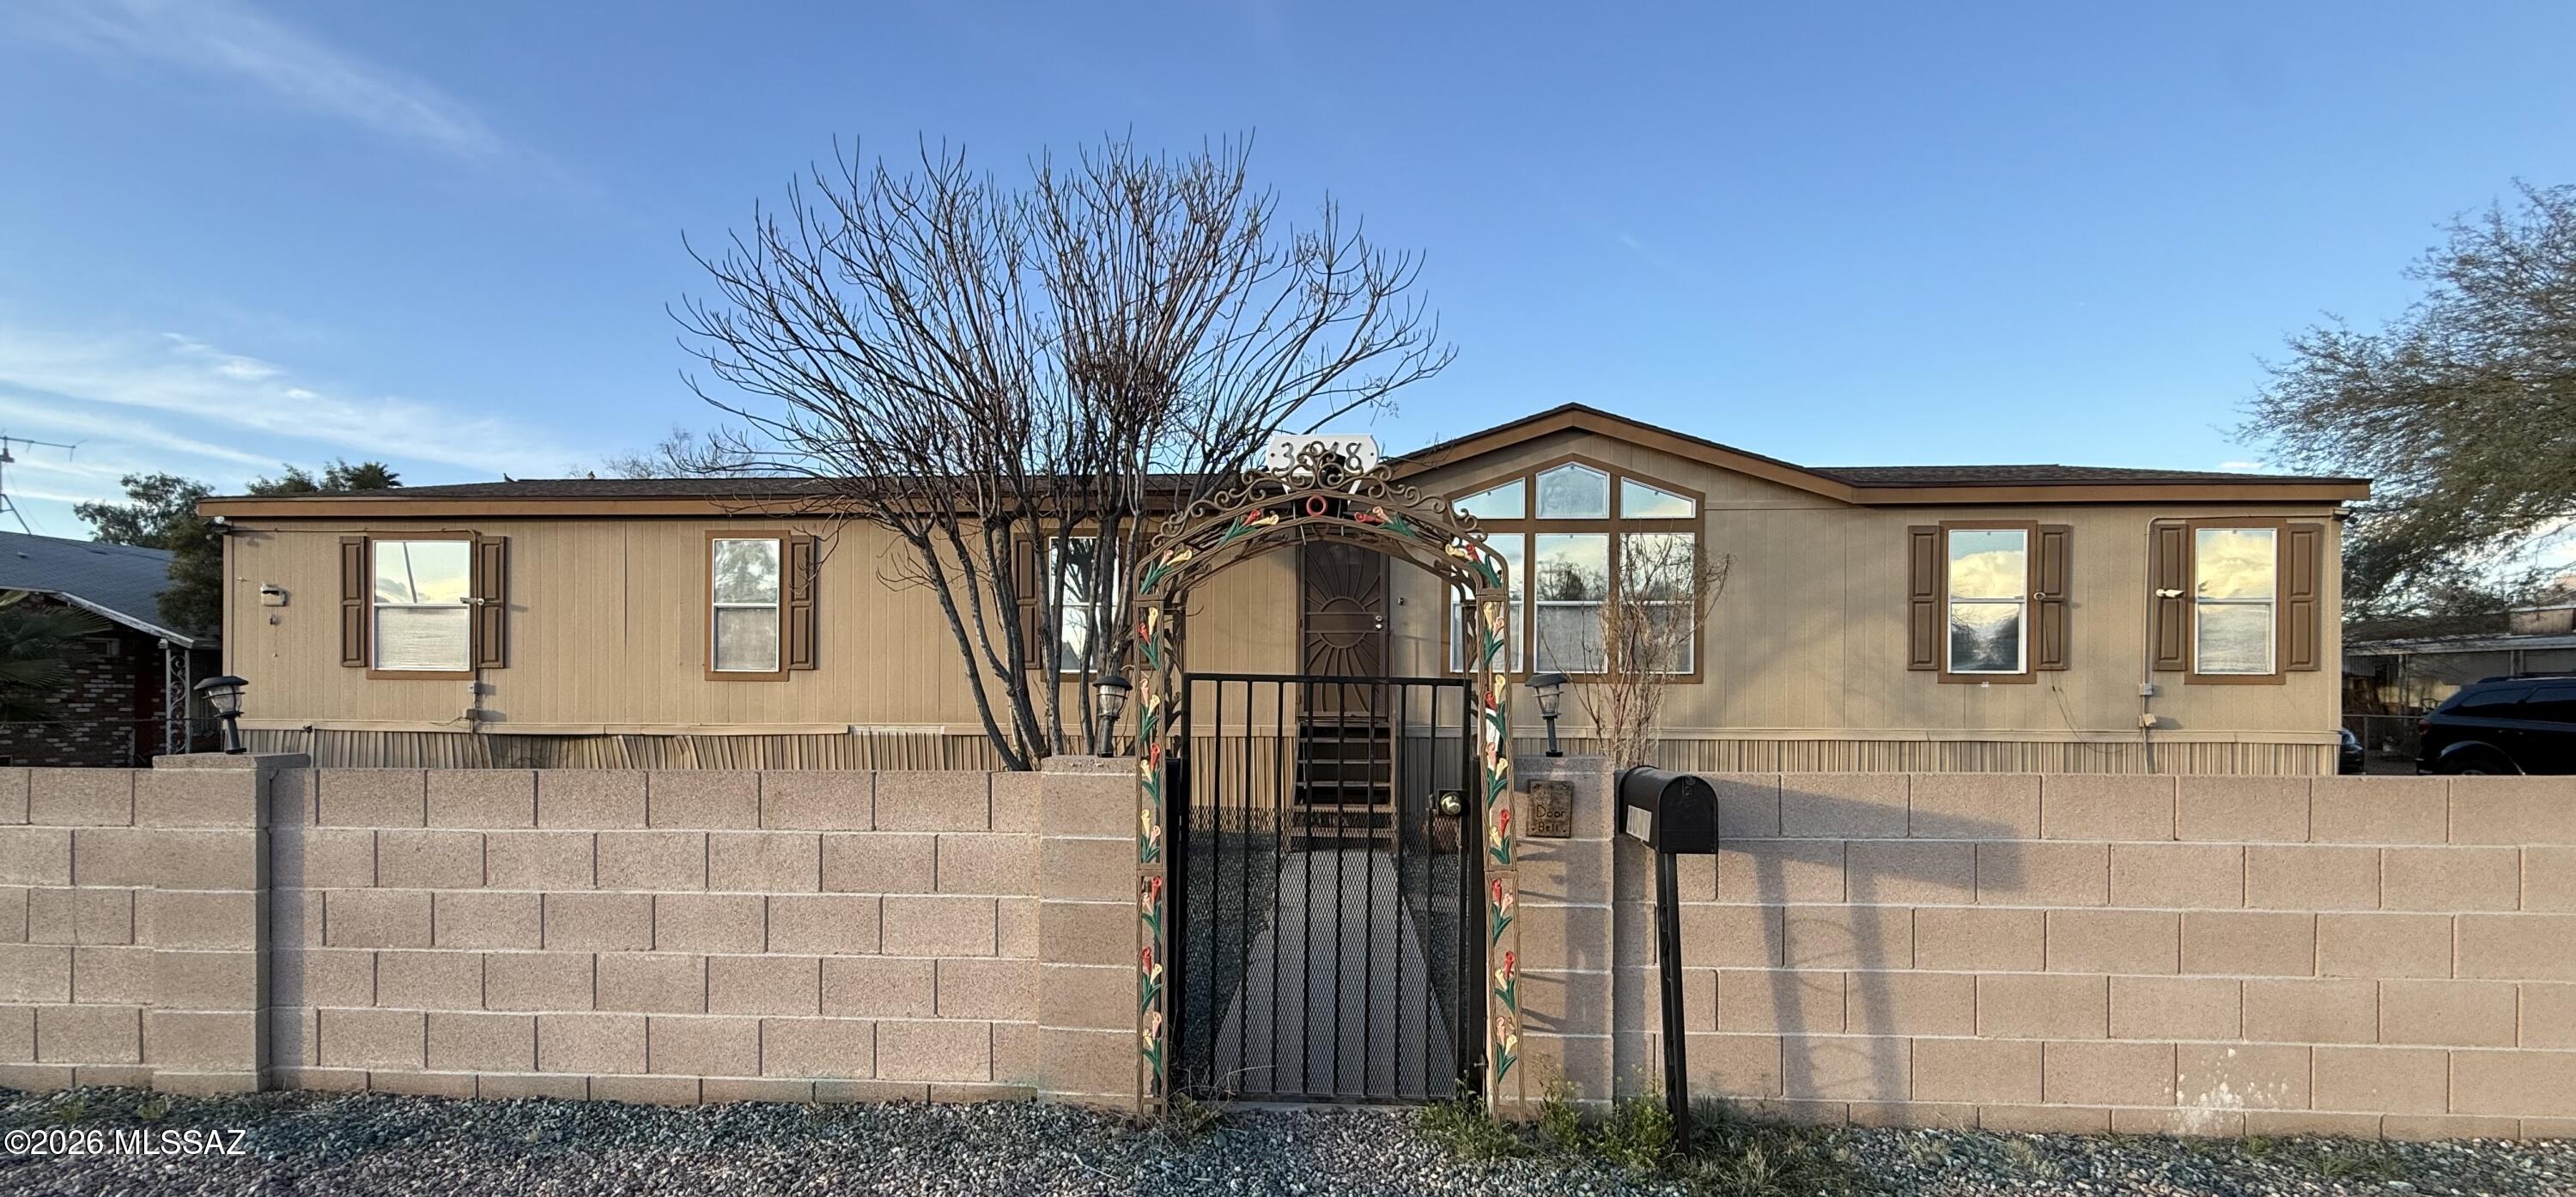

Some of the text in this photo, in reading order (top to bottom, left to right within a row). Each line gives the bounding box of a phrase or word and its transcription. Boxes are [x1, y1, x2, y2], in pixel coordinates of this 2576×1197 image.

[1279, 441, 1364, 471] 38
[1537, 805, 1566, 817] Door
[1539, 821, 1558, 832] Bell
